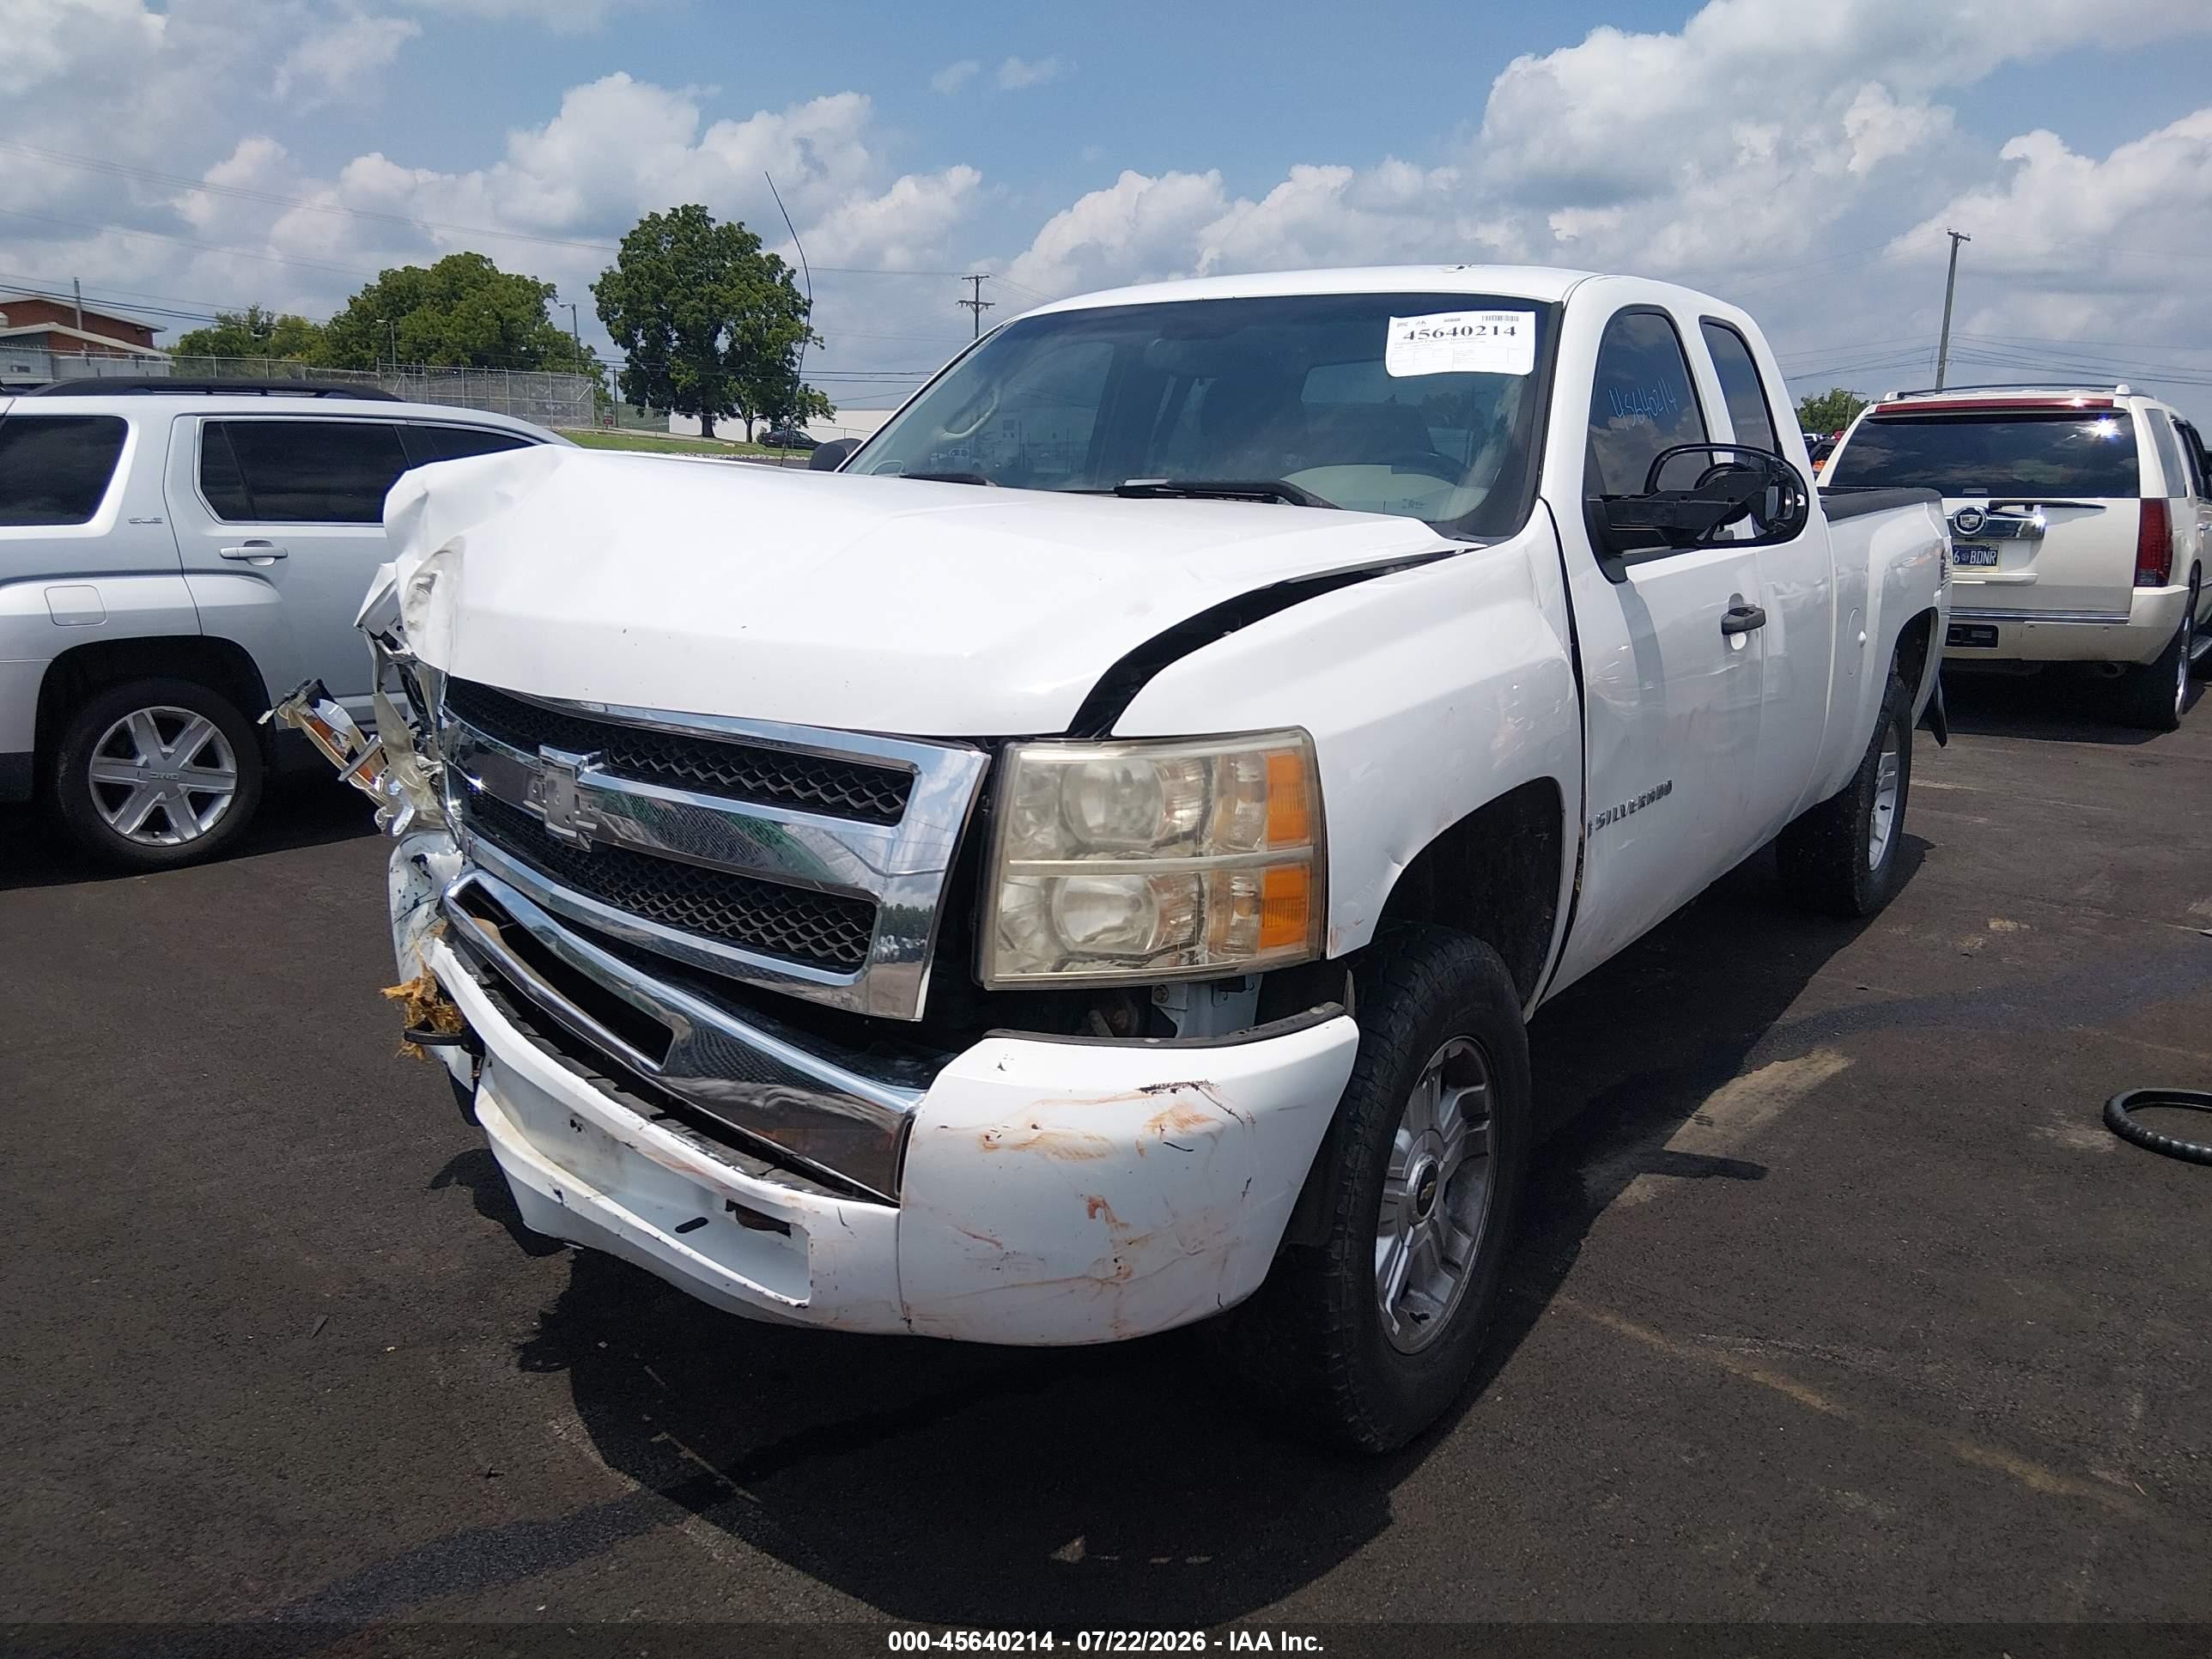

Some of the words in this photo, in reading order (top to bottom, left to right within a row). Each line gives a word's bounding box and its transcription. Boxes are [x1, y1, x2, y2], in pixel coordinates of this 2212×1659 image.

[1403, 325, 1516, 340] 45640214
[1608, 377, 1678, 431] 45640214
[1970, 550, 1996, 564] BDNR
[1595, 778, 1674, 830] SILVERADO
